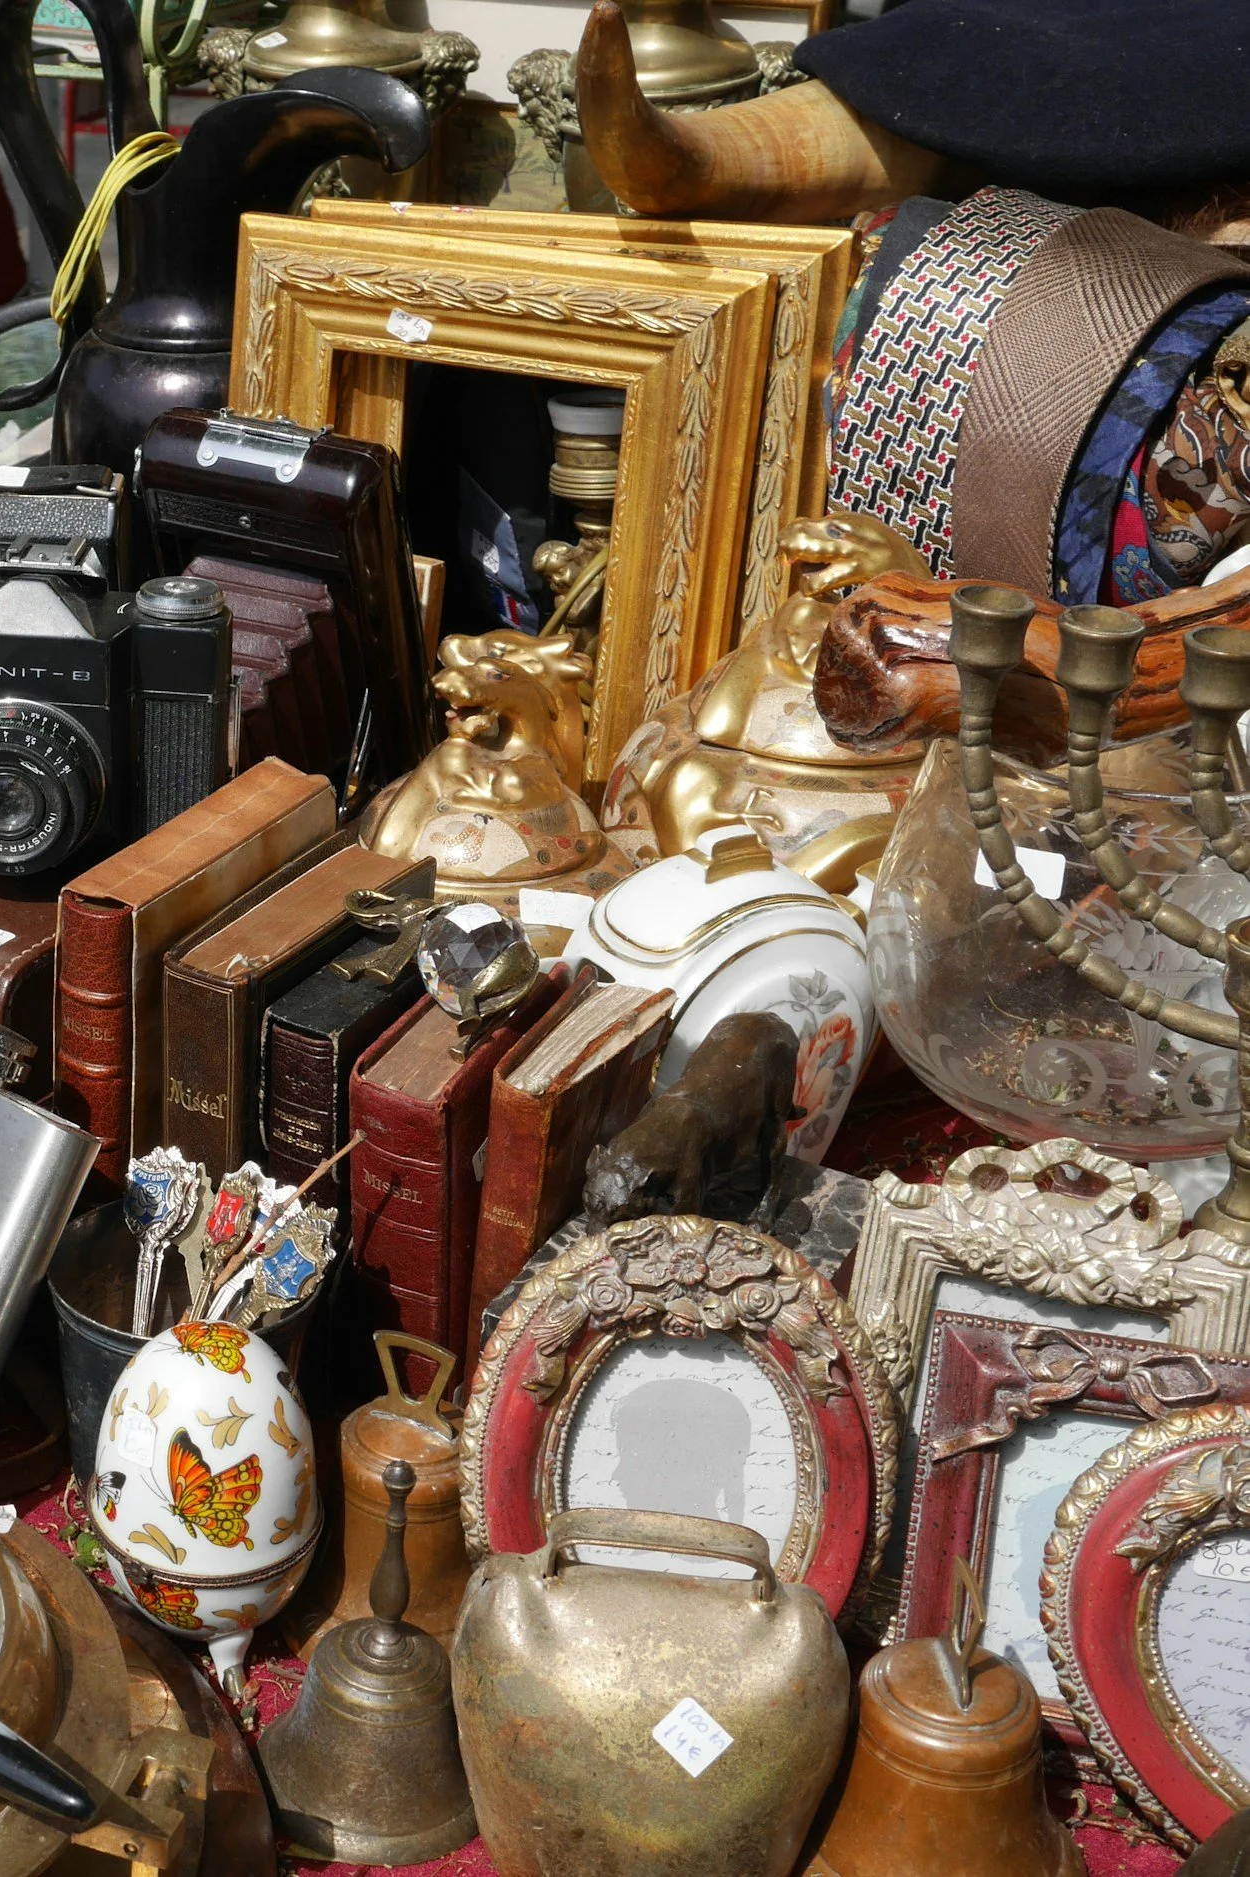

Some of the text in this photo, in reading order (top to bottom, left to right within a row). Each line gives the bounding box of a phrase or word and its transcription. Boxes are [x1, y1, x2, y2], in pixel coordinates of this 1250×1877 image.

[62, 1013, 115, 1042] MISSEL
[167, 1077, 228, 1119] Missel
[363, 1168, 423, 1204] MISSEL
[492, 1206, 516, 1219] PETIT
